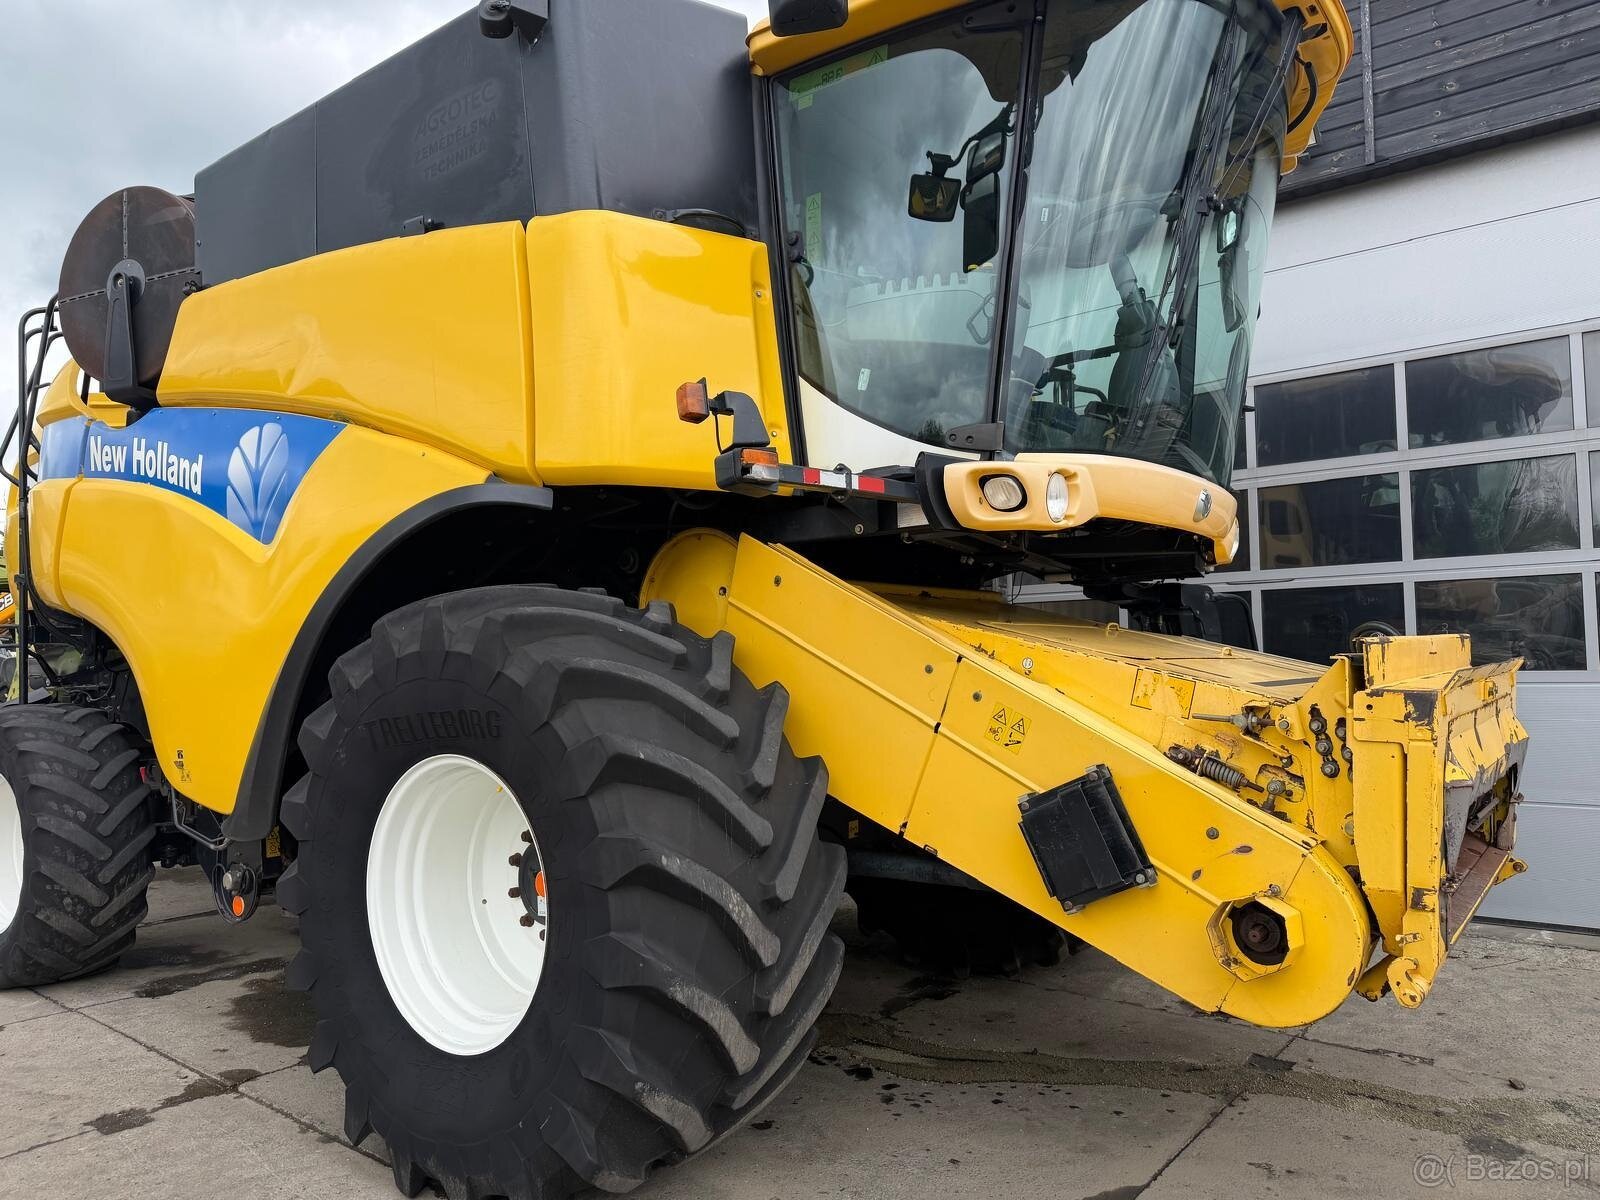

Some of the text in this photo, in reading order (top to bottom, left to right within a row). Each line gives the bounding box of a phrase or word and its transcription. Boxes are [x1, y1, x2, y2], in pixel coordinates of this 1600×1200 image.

[414, 81, 498, 141] AGROTEC
[89, 435, 204, 496] New Holland
[363, 708, 503, 752] TRELLEBORG
